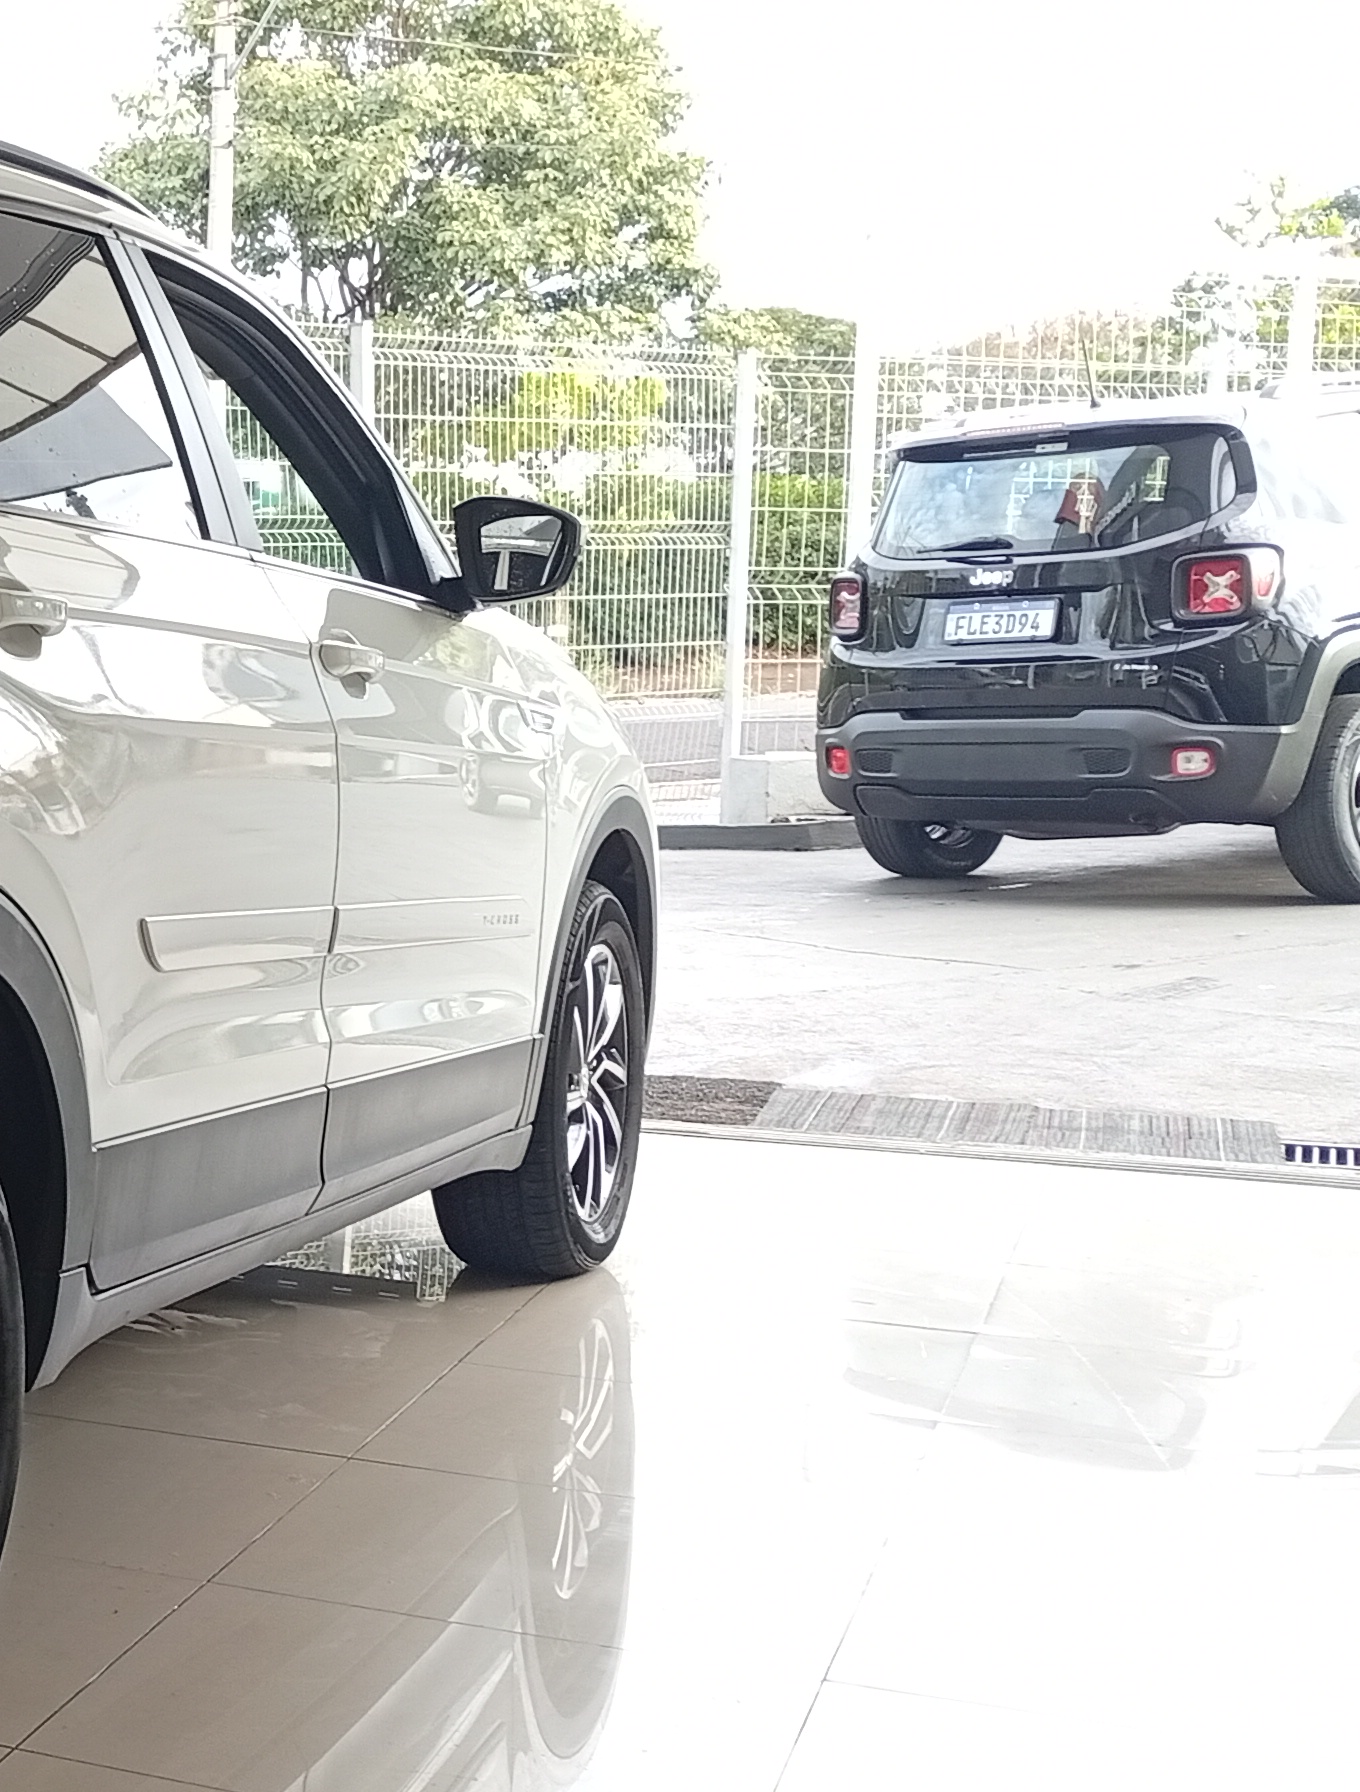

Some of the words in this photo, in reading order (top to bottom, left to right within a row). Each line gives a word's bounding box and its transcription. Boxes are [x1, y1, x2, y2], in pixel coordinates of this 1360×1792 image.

[969, 568, 1014, 587] Jeep
[954, 612, 1040, 636] FLE3D94
[483, 914, 520, 926] T-CROSS
